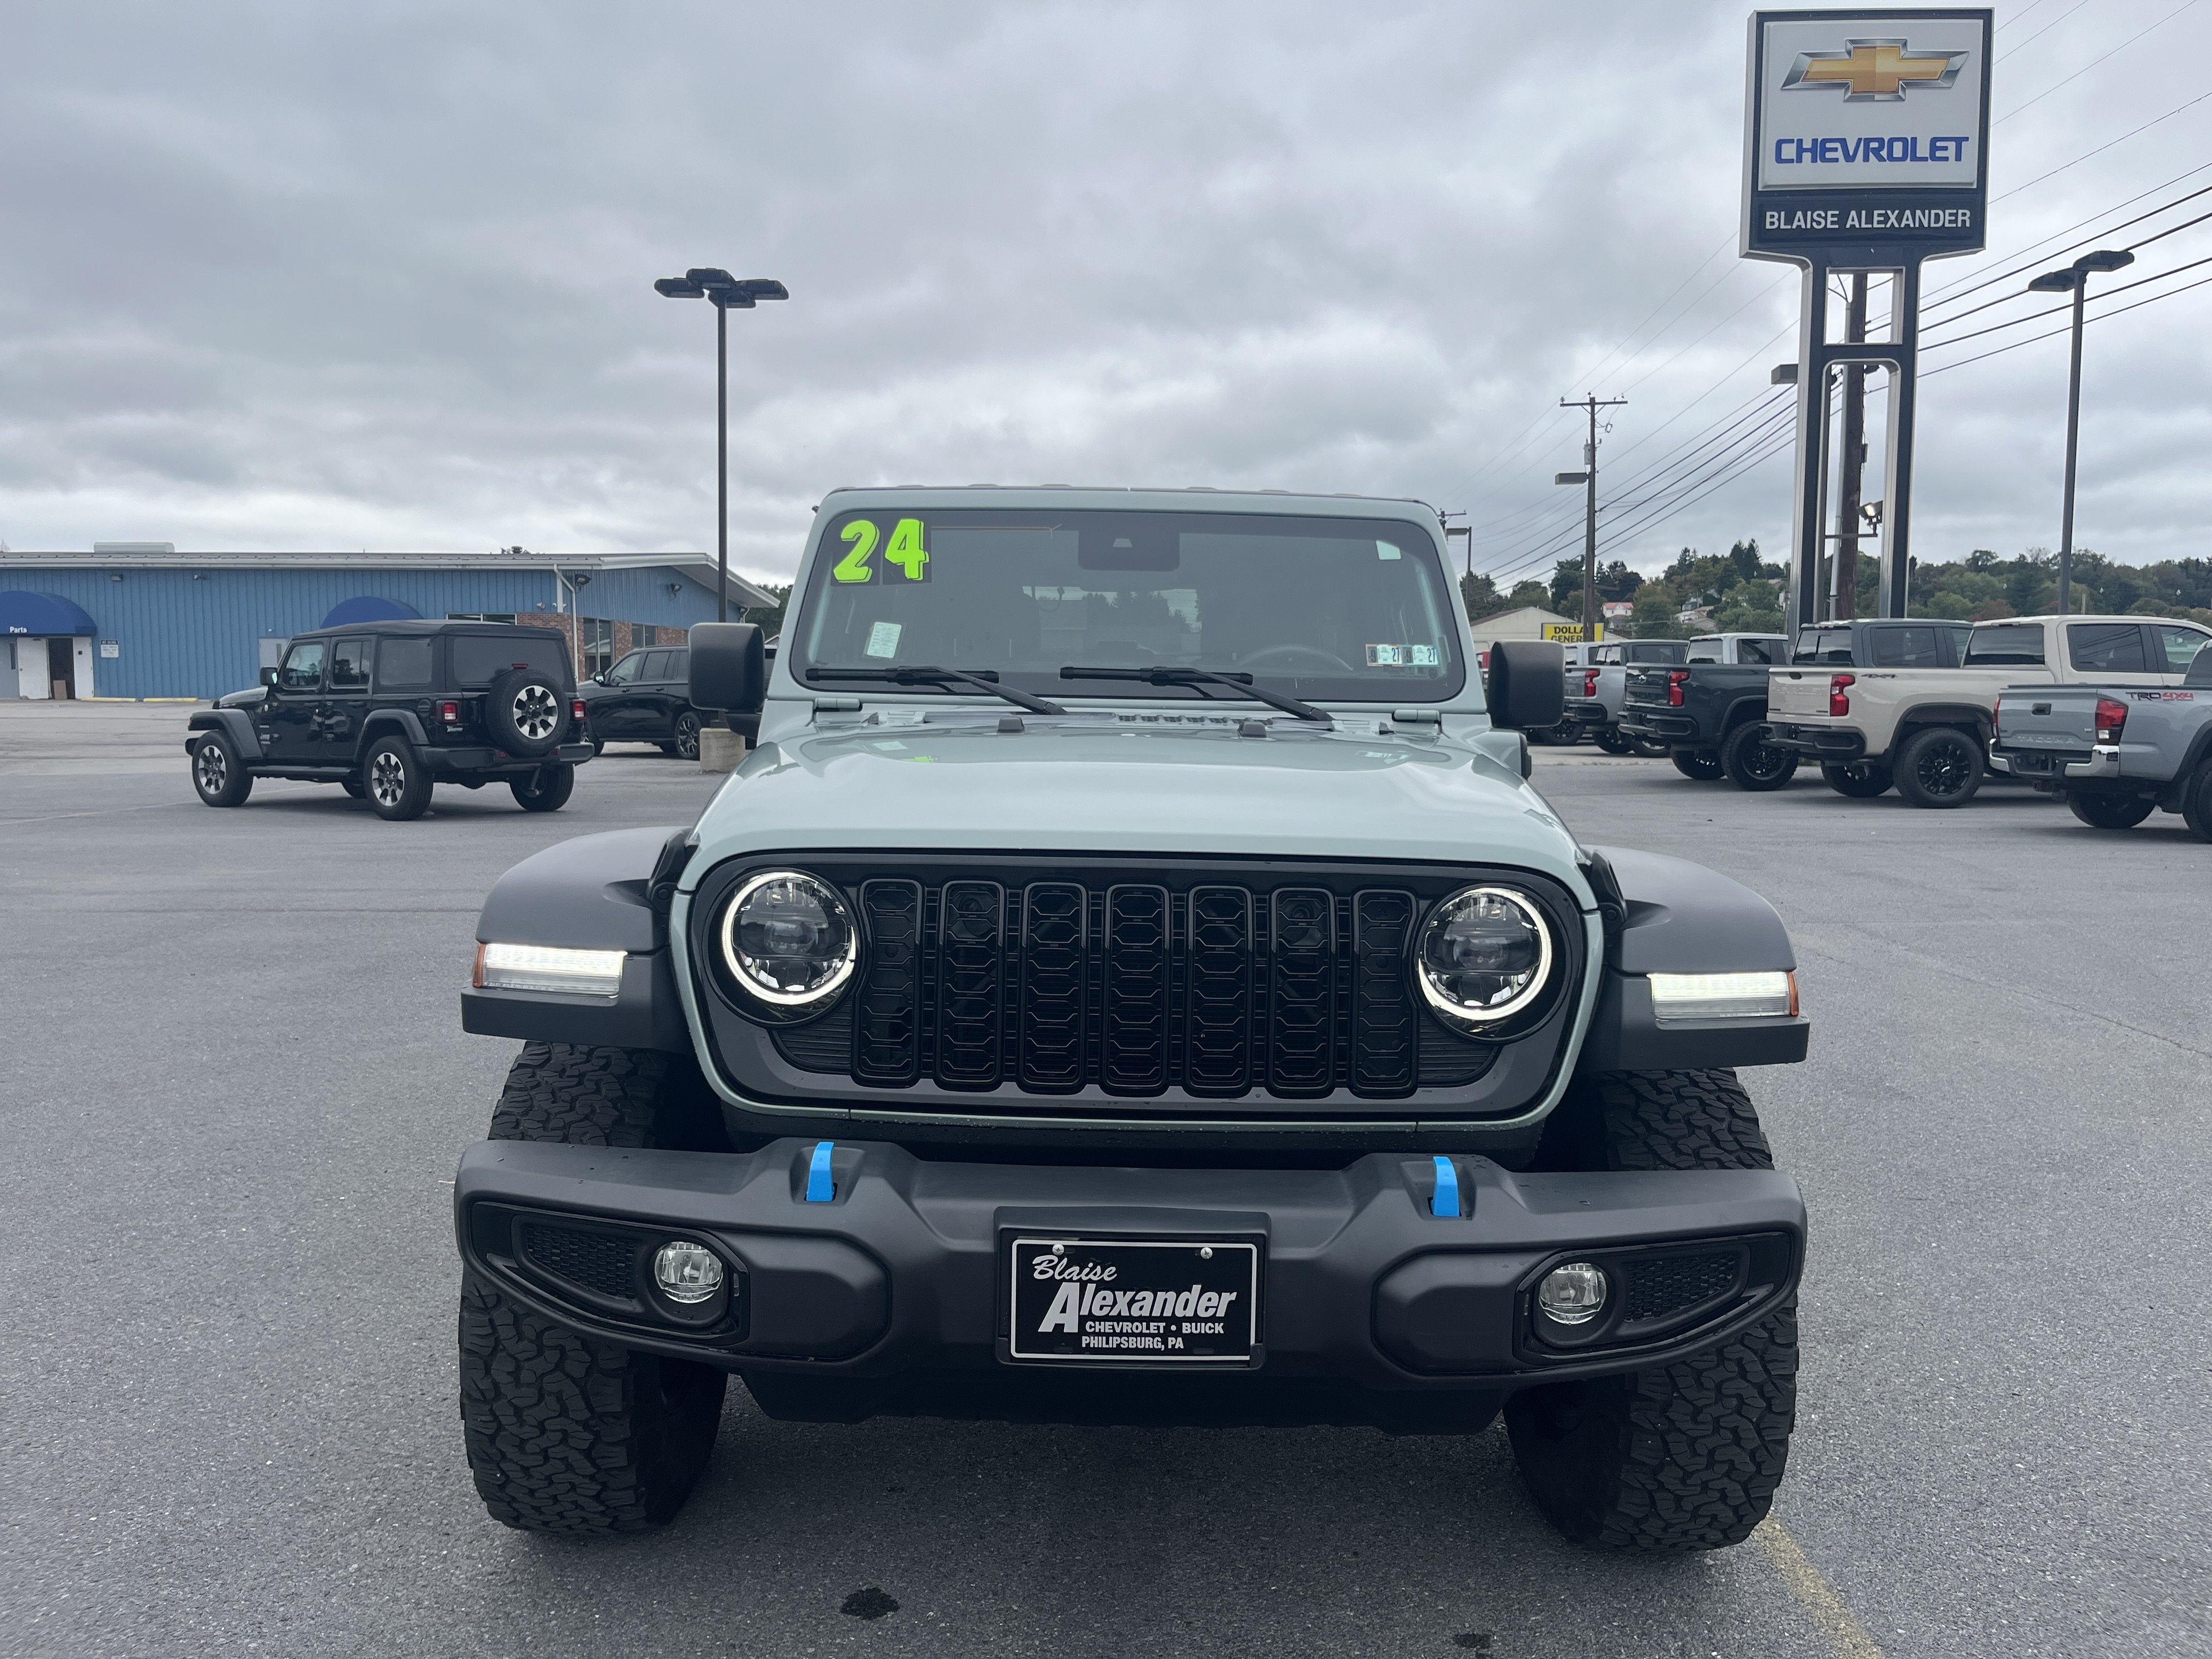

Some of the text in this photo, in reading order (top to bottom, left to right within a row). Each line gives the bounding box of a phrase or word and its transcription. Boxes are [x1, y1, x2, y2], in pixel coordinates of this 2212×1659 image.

[1775, 137, 1970, 163] CHEVROLET
[1765, 209, 1971, 230] BLAISE ALEXANDER
[833, 518, 930, 584] 24
[1554, 626, 1584, 634] DOLLA
[2125, 692, 2161, 701] TRD
[1032, 1255, 1118, 1282] Blaise
[1038, 1282, 1237, 1333] Alexander
[1085, 1321, 1224, 1334] CHEVROLET BUICK
[1081, 1336, 1184, 1351] PHILIPSBURG, PA
